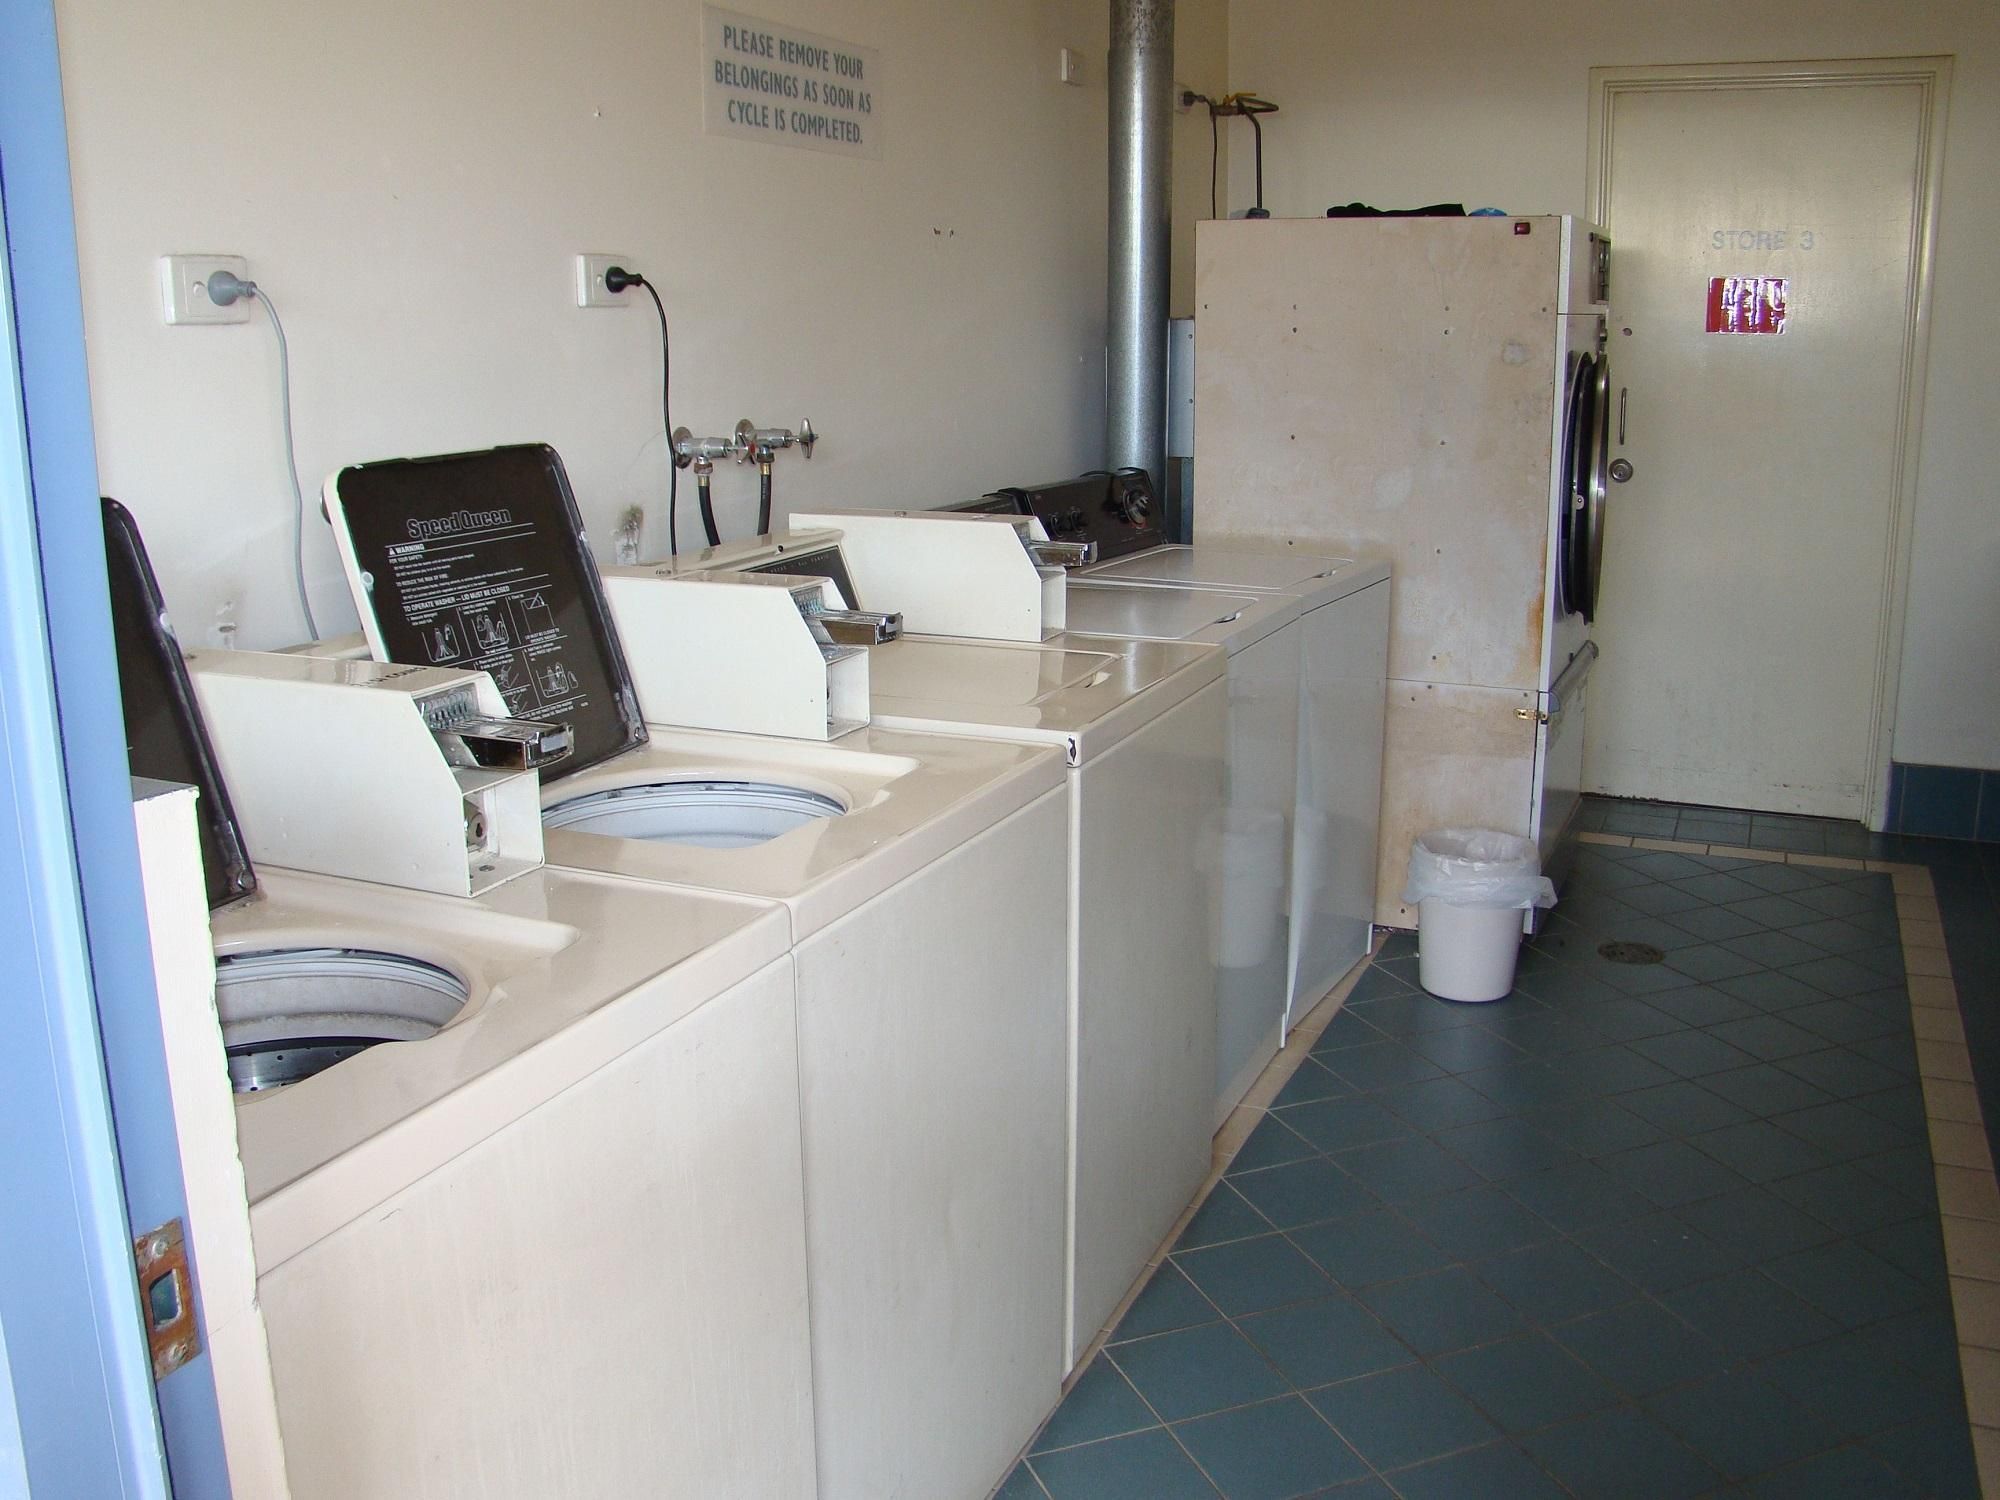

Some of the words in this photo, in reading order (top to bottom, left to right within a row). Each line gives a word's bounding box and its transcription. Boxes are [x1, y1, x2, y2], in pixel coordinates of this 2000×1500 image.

[724, 25, 774, 58] PLEASE
[780, 39, 829, 72] REMOVE
[833, 53, 864, 80] YOUR
[716, 60, 798, 98] BELONGINGS
[803, 79, 818, 103] AS
[823, 83, 854, 110] SOON
[858, 93, 871, 114] AS
[728, 99, 768, 128] CYCLE
[775, 108, 785, 131] IS
[791, 111, 863, 145] COMPLETED.
[1712, 230, 1786, 250] STORE
[1799, 230, 1814, 251] 3
[407, 512, 460, 540] Speed
[461, 509, 511, 530] Queen
[395, 544, 424, 553] WARNING
[403, 605, 411, 613] TO
[411, 602, 434, 611] OPERATE
[470, 591, 483, 599] MUST
[490, 585, 510, 595] CLOSED
